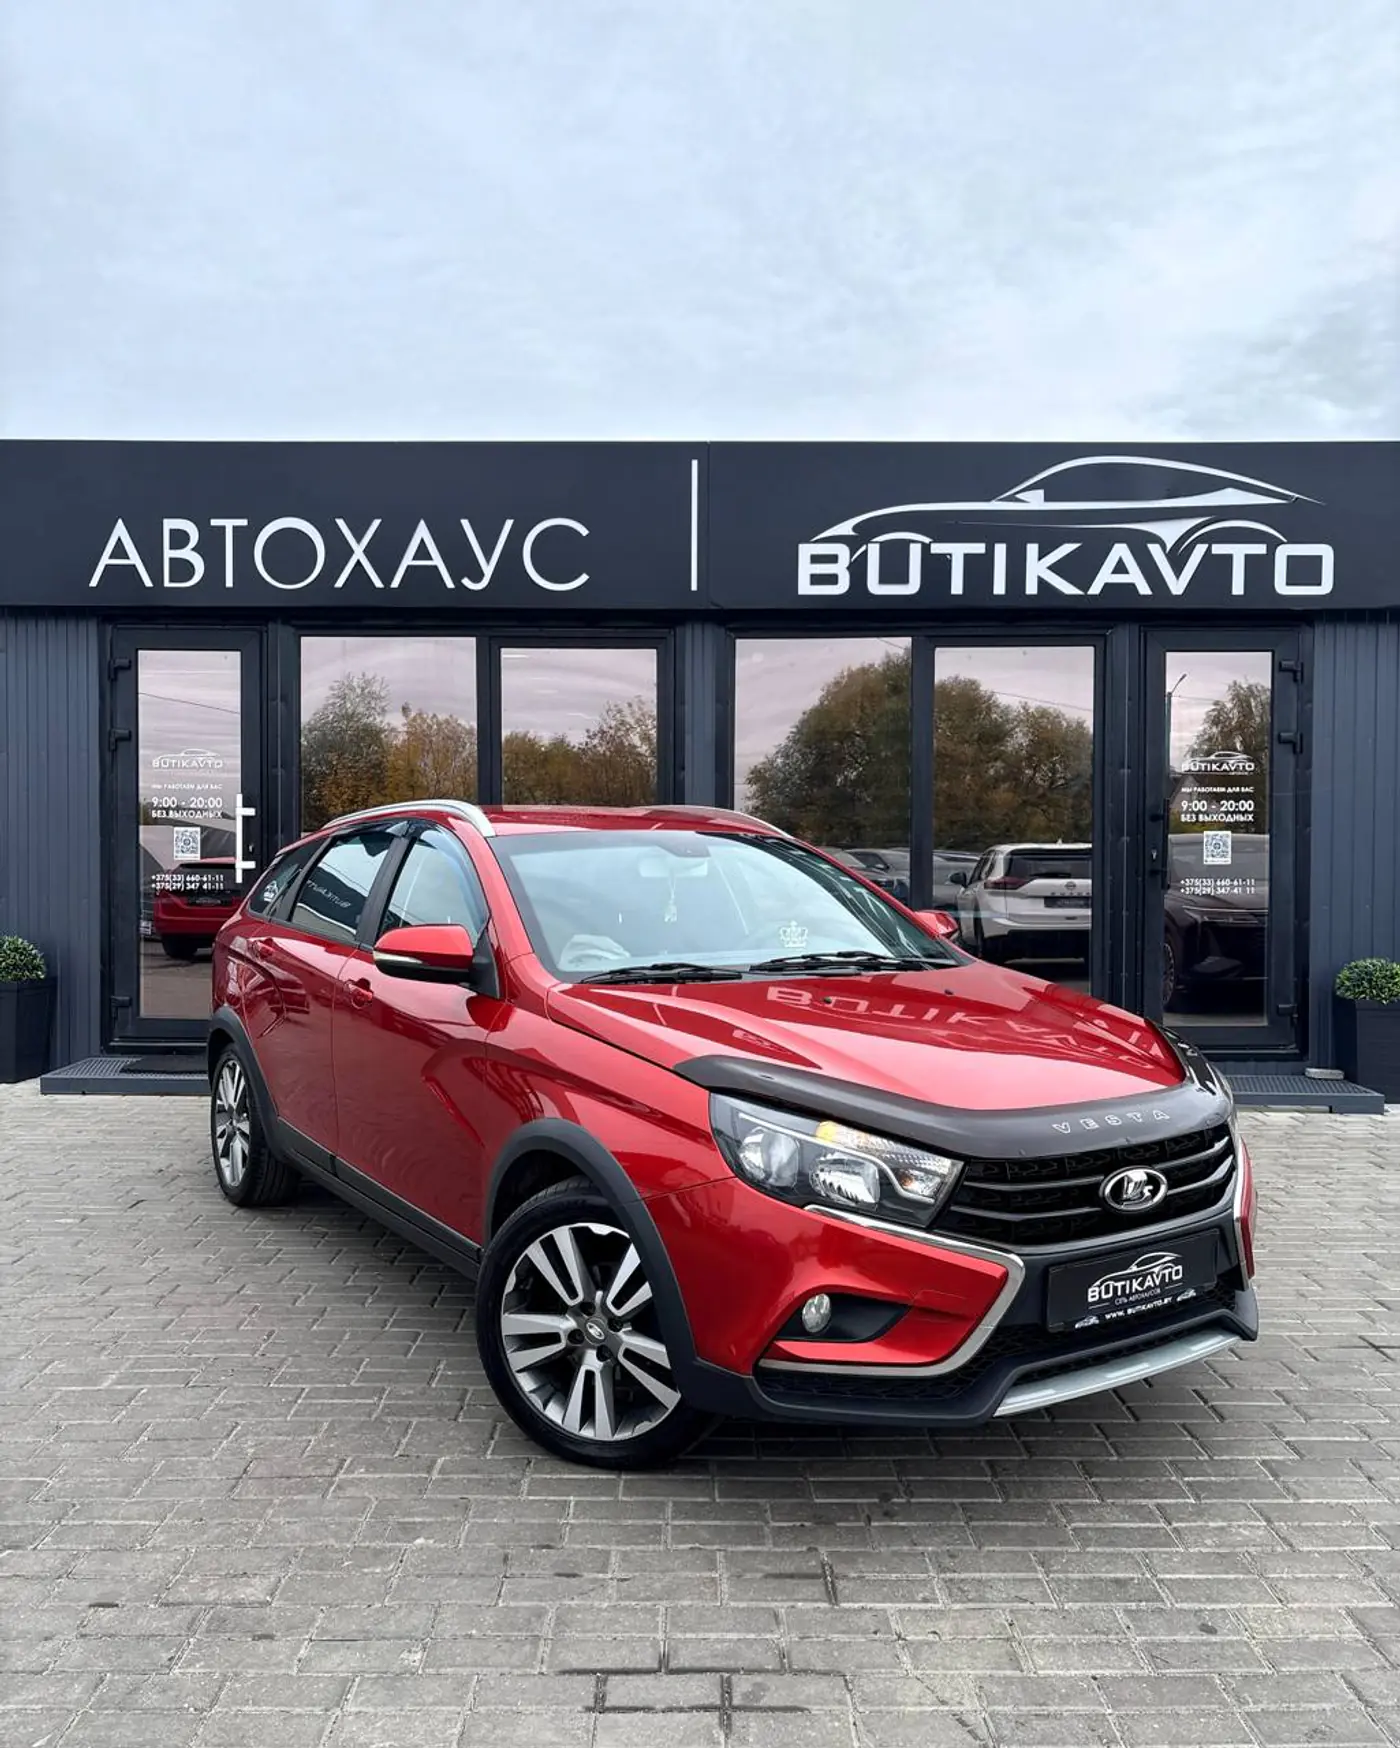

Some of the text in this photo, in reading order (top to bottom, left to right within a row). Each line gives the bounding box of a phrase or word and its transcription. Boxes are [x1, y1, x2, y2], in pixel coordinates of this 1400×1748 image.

[89, 517, 590, 591] АВТОХАУС
[797, 543, 1335, 596] BUTIKAVTO
[152, 759, 223, 769] BUTIKAVTO
[1181, 762, 1255, 772] BUTIKAVTO
[151, 796, 178, 808] 9:00
[189, 796, 223, 808] 20:00
[1181, 800, 1208, 811] 9:00
[1220, 800, 1254, 811] 20:00
[151, 809, 222, 819] БЕЗ ВЫХОДНЫХ
[1181, 813, 1254, 823] БЕЗ ВЫХОДНЫХ
[1052, 1109, 1170, 1134] VESTA
[1087, 1265, 1182, 1302] BUTIKAVTO
